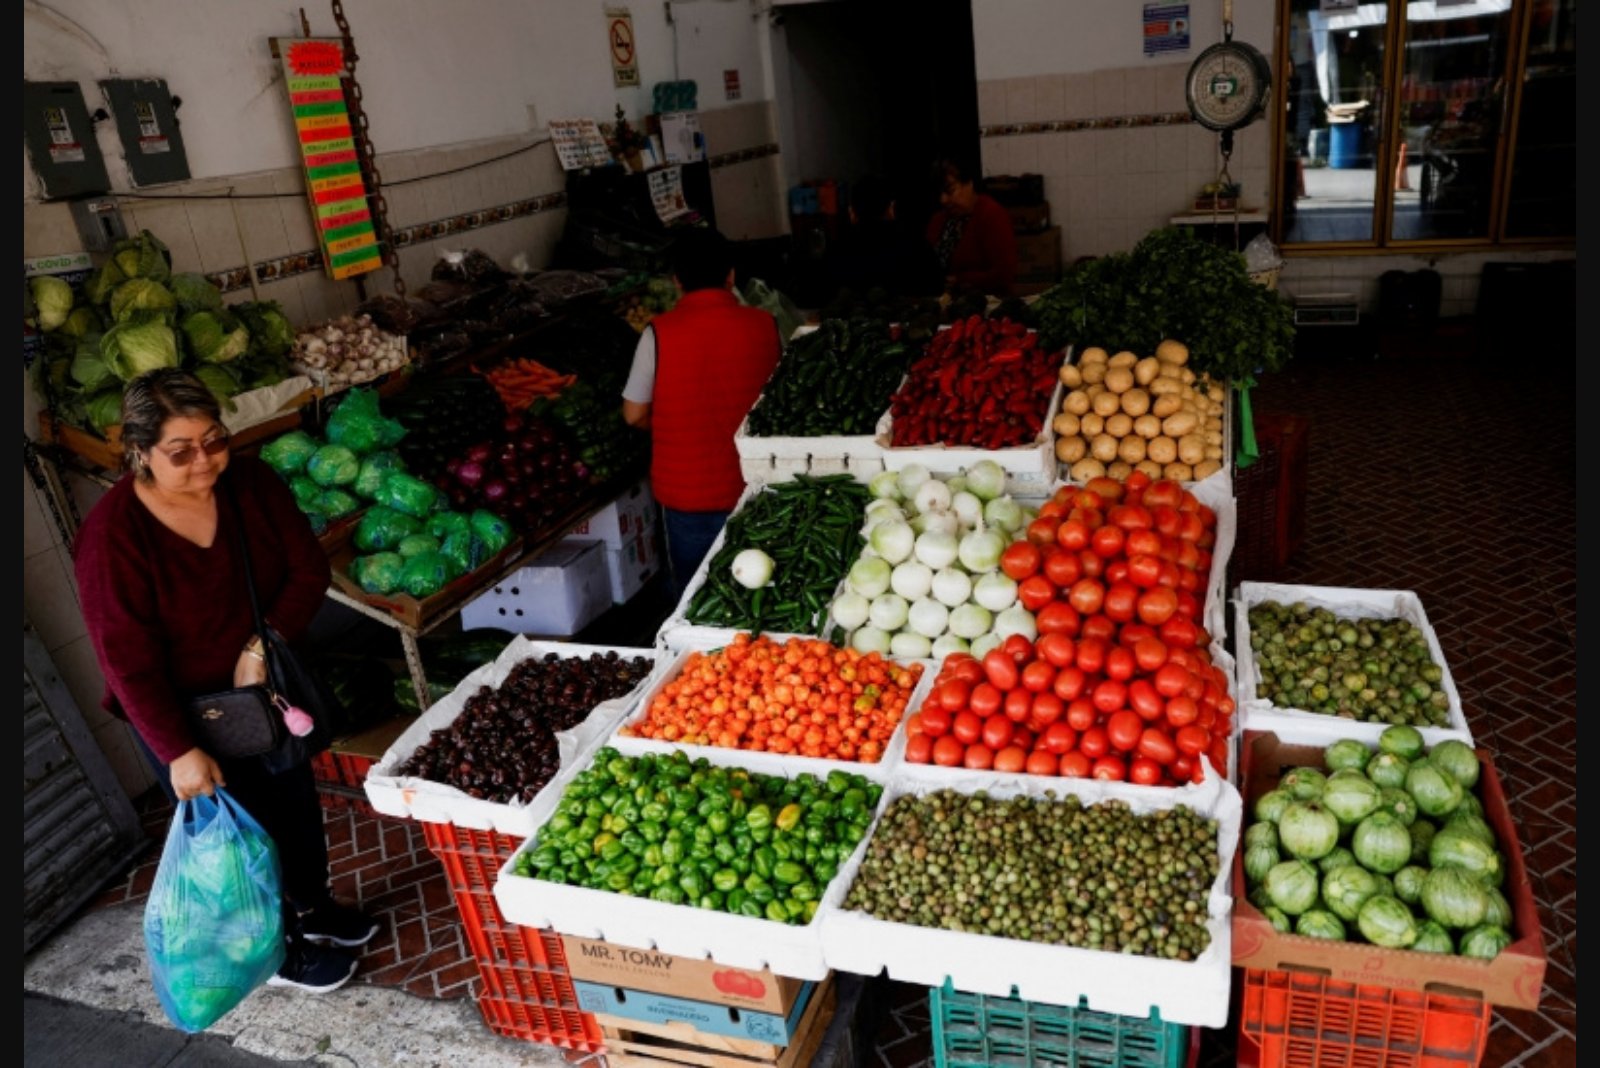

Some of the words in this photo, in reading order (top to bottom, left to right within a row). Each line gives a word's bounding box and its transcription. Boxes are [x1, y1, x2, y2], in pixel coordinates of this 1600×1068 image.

[37, 257, 72, 269] COVID
[581, 943, 615, 960] MR.
[617, 949, 673, 970] TOMY
